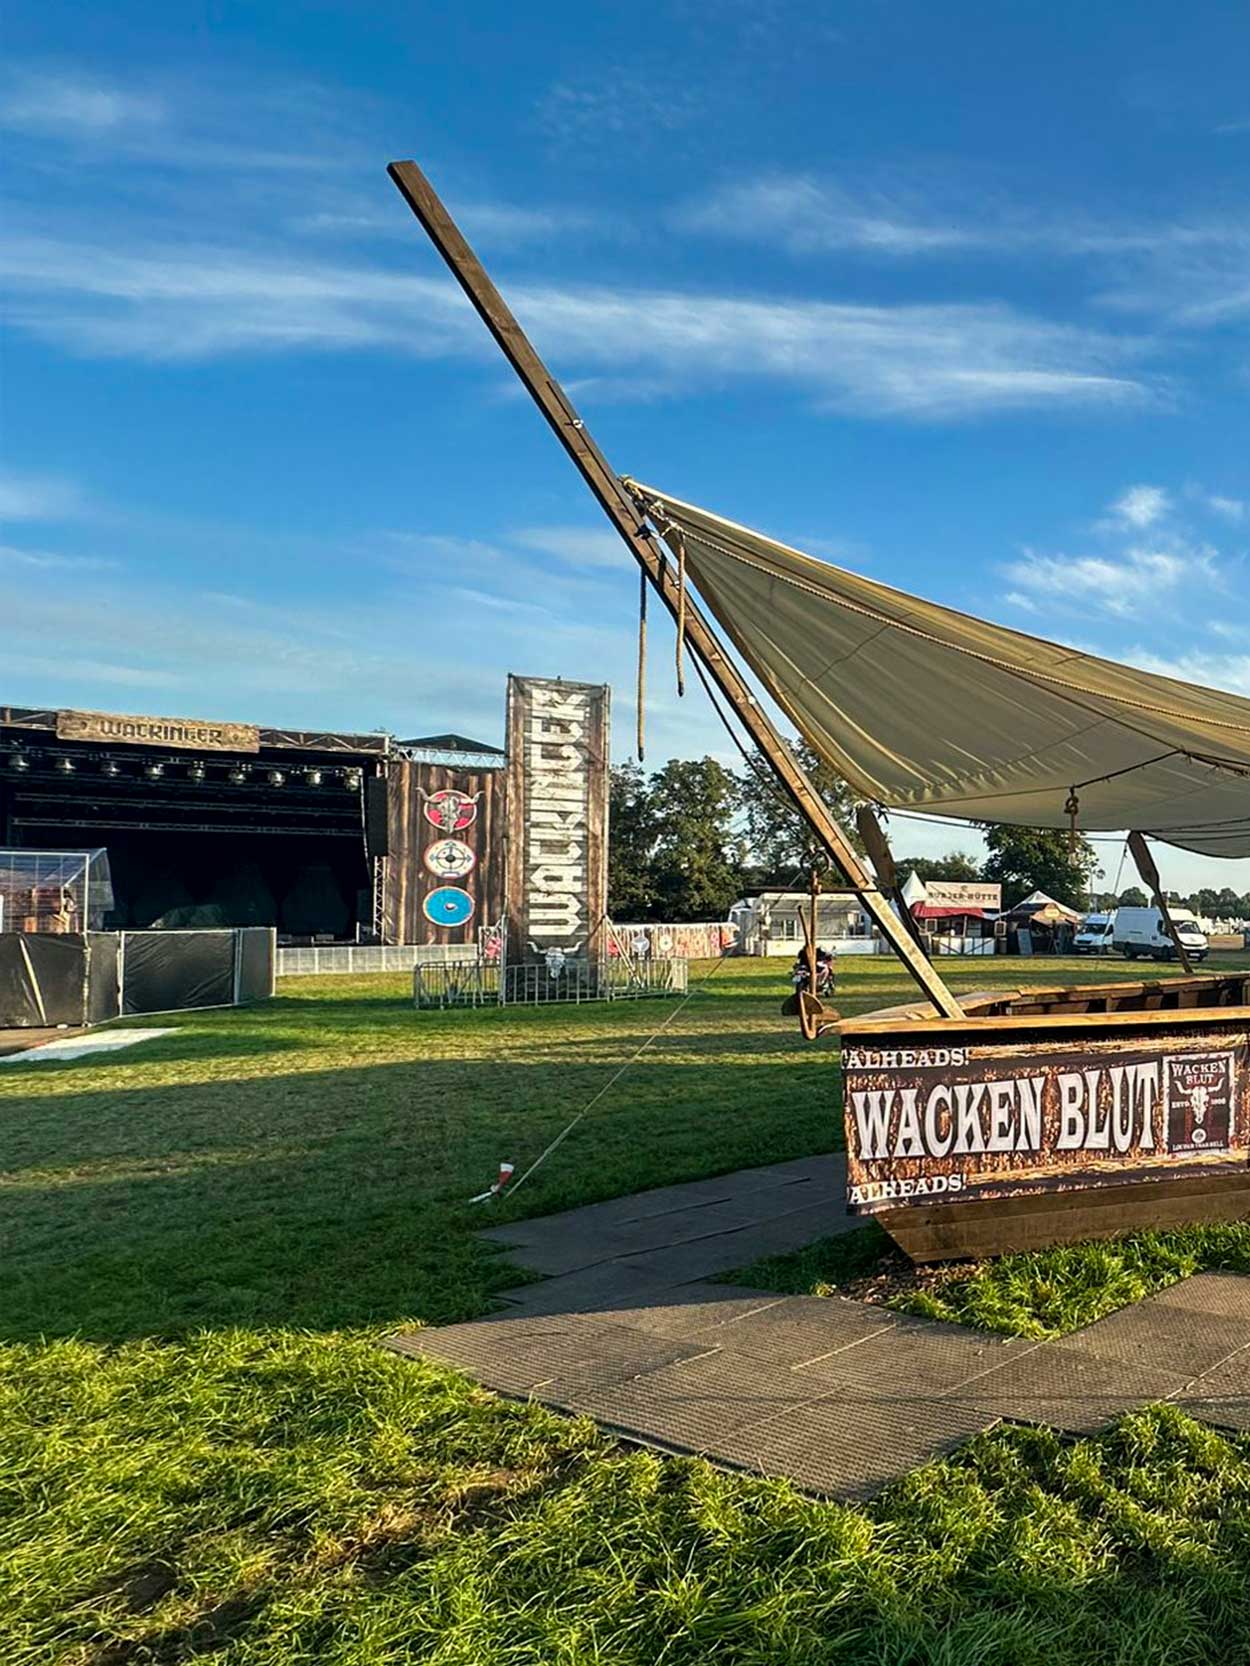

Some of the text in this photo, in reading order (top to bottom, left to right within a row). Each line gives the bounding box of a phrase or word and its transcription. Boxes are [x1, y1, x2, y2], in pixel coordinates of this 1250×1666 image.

[100, 720, 223, 744] WACKINGER
[527, 688, 590, 935] WACKINGER
[1171, 1060, 1227, 1077] WACKEN
[1186, 1074, 1215, 1085] BLUT
[851, 1061, 1159, 1160] WACKEN BLUT
